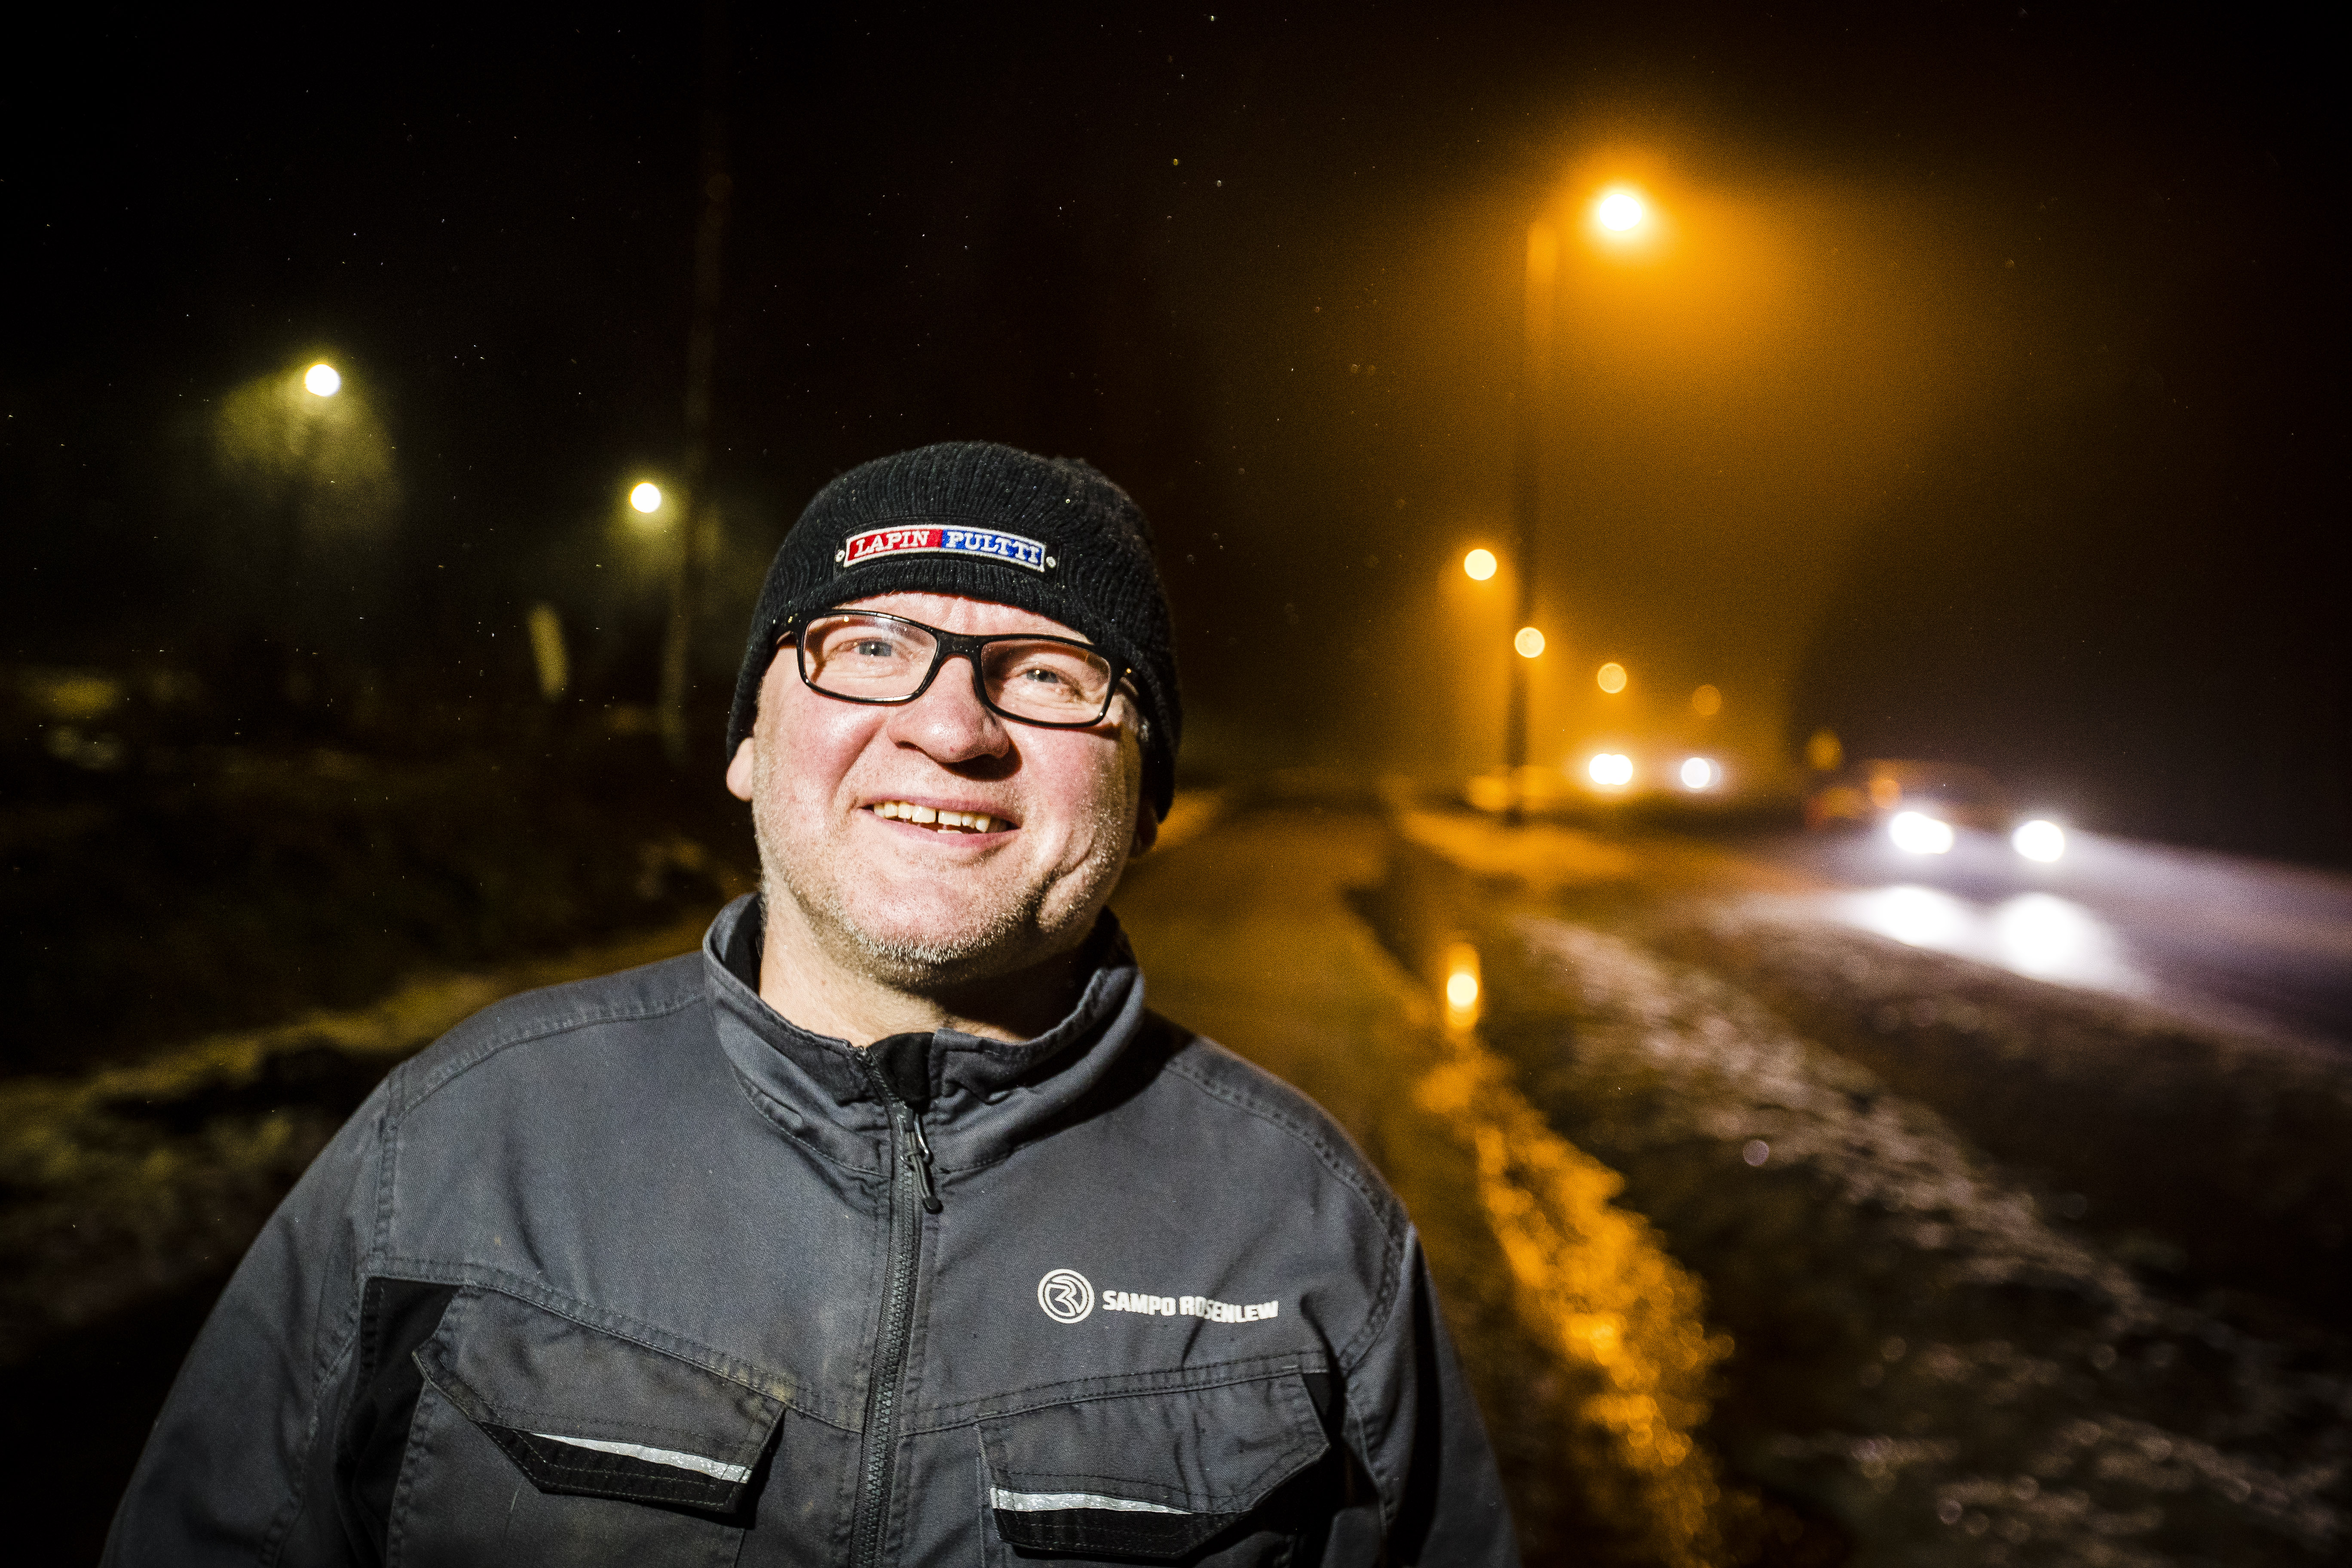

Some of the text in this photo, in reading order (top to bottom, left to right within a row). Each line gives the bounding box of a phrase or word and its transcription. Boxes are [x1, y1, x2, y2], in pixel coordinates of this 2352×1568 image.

[854, 530, 1040, 564] LAPIN PULTTI
[1102, 1290, 1278, 1323] SAMPO ROSENLEW
